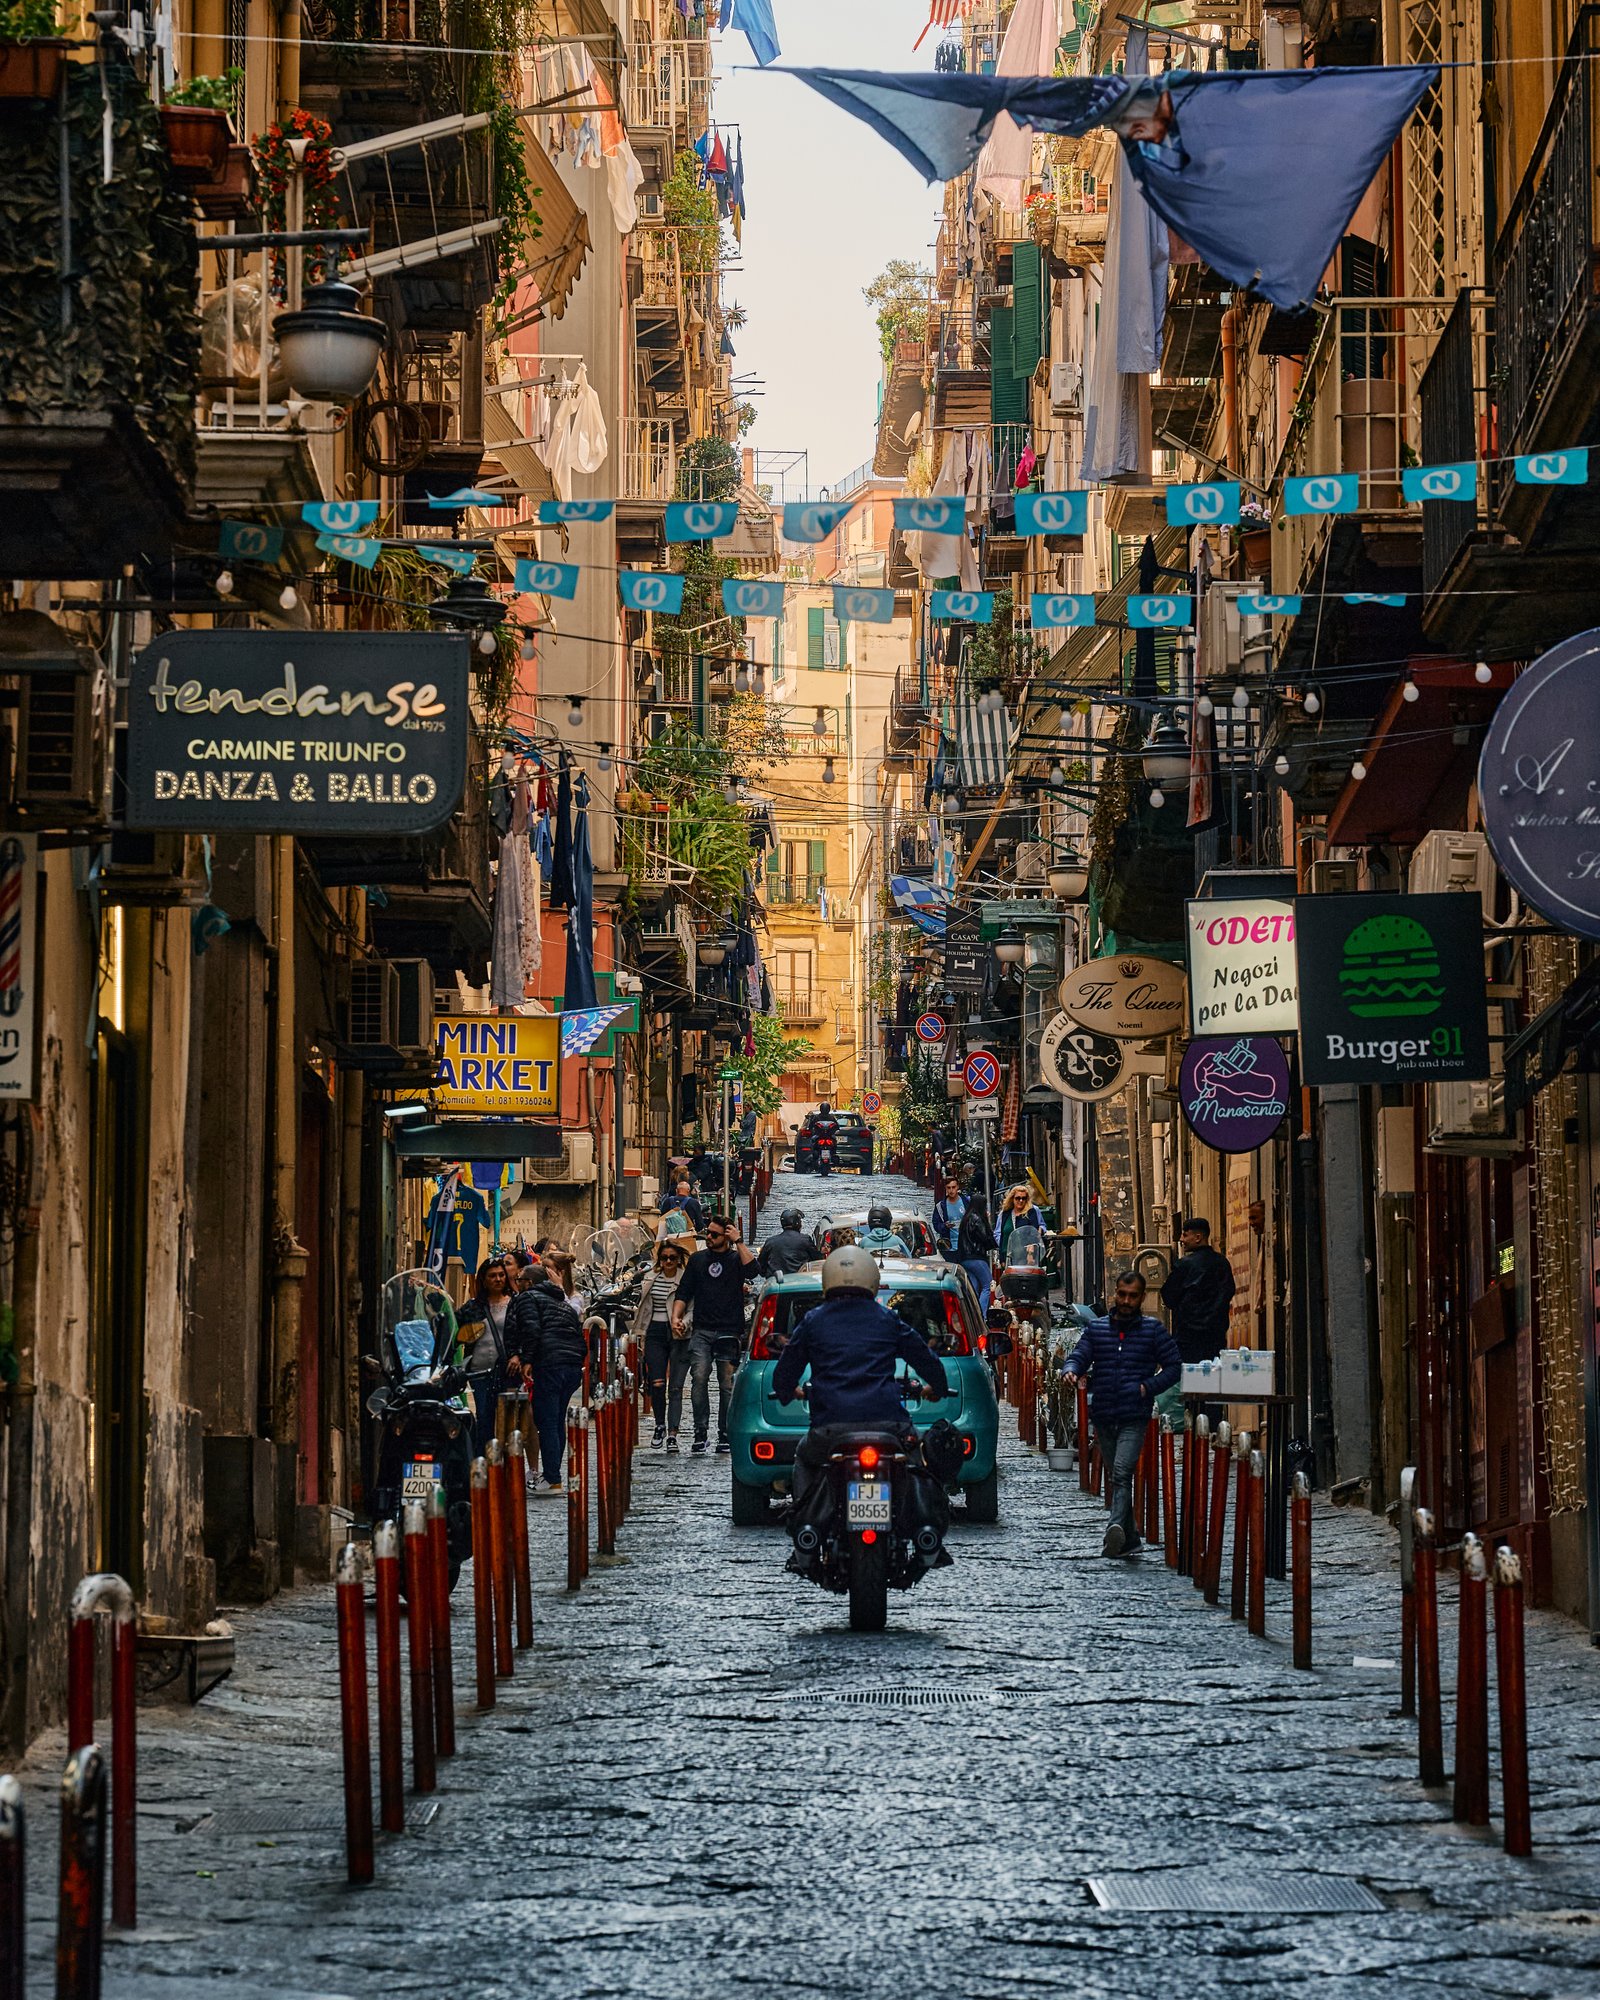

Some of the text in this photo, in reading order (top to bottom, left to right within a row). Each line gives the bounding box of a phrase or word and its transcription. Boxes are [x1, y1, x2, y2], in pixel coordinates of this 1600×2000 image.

[1536, 456, 1560, 474] N
[1429, 473, 1452, 490] N
[1310, 482, 1334, 502] N
[327, 503, 352, 522] N
[1040, 501, 1063, 522] N
[1192, 492, 1217, 513] N
[693, 506, 715, 526] N
[918, 504, 941, 523] N
[149, 657, 446, 727] tendanse
[402, 719, 446, 732] dal 1975
[187, 738, 406, 763] CARMINE TRIUNFO
[154, 770, 437, 804] DANZA & BALLO
[1213, 956, 1278, 988] Negozi
[1070, 981, 1118, 1010] The
[1198, 1002, 1228, 1026] per
[1234, 992, 1258, 1013] la
[1117, 1022, 1144, 1030] Noemi
[437, 1022, 518, 1056] MINI
[1046, 1030, 1058, 1046] BY
[436, 1057, 554, 1092] ARKET
[1396, 1058, 1465, 1071] pub and beer
[485, 1096, 497, 1106] Tel.
[1188, 1097, 1286, 1124] Manosanta
[453, 1213, 464, 1250] 7
[412, 1464, 426, 1478] EL
[404, 1481, 439, 1494] 4200
[858, 1485, 874, 1499] FJ
[850, 1504, 888, 1518] 98563
